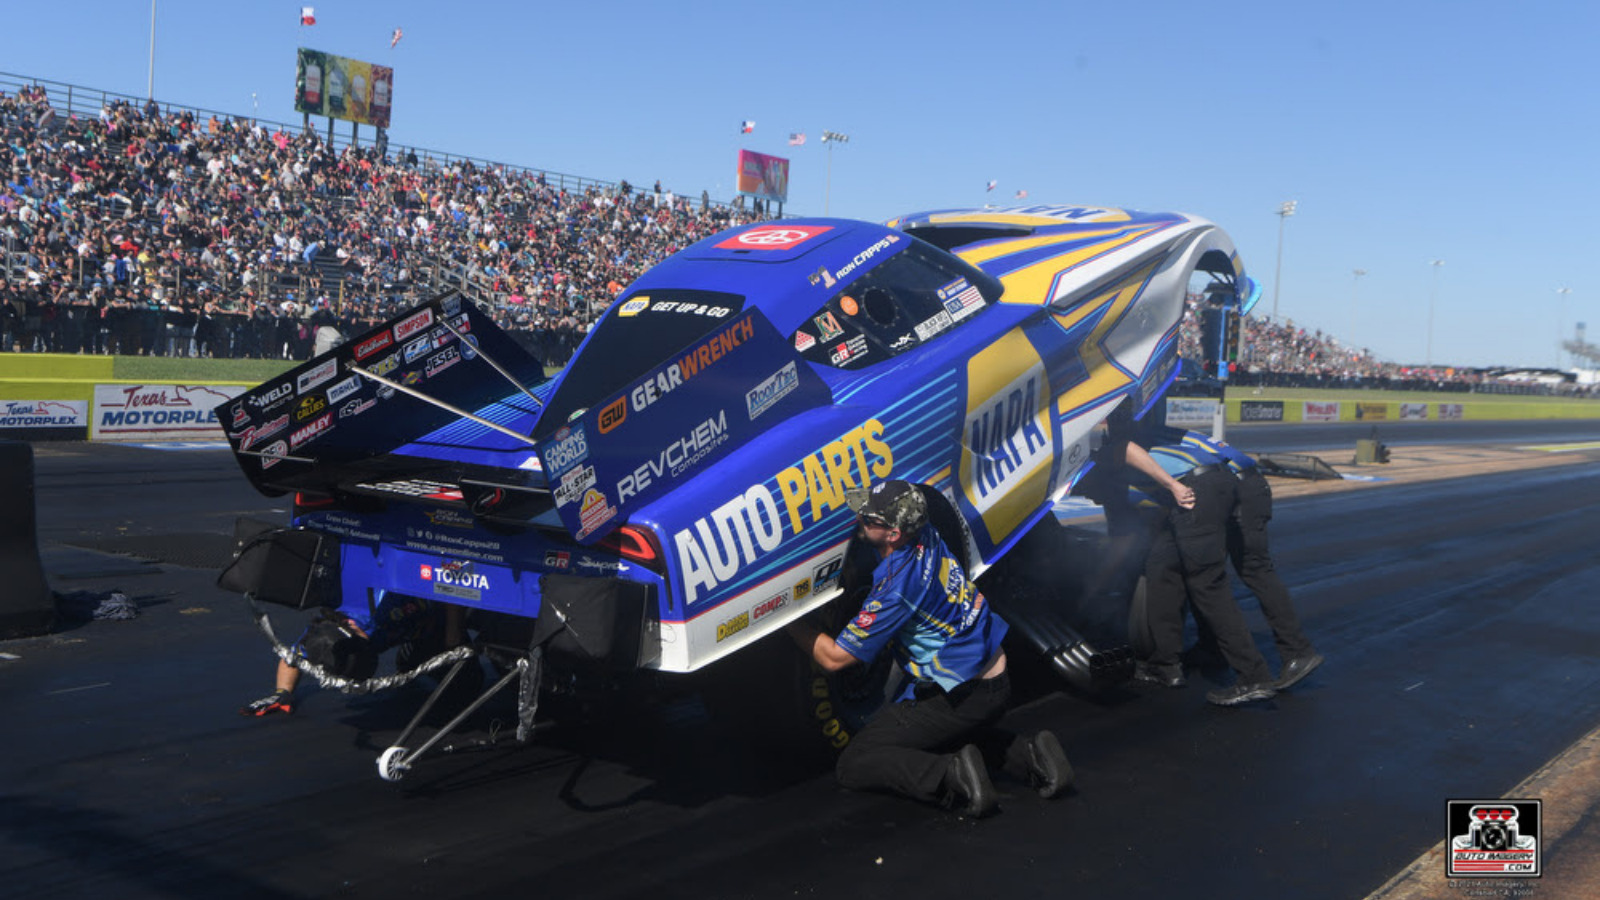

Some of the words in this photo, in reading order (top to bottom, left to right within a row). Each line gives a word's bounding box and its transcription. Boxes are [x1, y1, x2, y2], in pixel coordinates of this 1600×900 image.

[836, 262, 856, 280] RON
[853, 239, 890, 266] CAPPS
[651, 301, 679, 311] GET
[676, 302, 698, 313] UP
[694, 305, 708, 315] &
[706, 306, 730, 317] GO
[397, 312, 430, 338] SIMPSON
[425, 346, 460, 372] JESEL
[631, 315, 754, 412] GEARWRENCH
[123, 385, 167, 409] Texas
[259, 382, 292, 407] WELD
[6, 402, 33, 416] Texas
[101, 410, 220, 426] MOTORPLE
[290, 414, 331, 445] MANLEY
[972, 375, 1046, 498] NAPA
[545, 428, 584, 460] CAMPING
[547, 441, 587, 473] WORLD
[617, 409, 728, 504] REVCHEM
[674, 483, 783, 605] AUTO
[775, 418, 893, 534] PARTS
[545, 556, 568, 568] GR
[434, 567, 490, 590] TOYOTA
[753, 595, 782, 619] COMP
